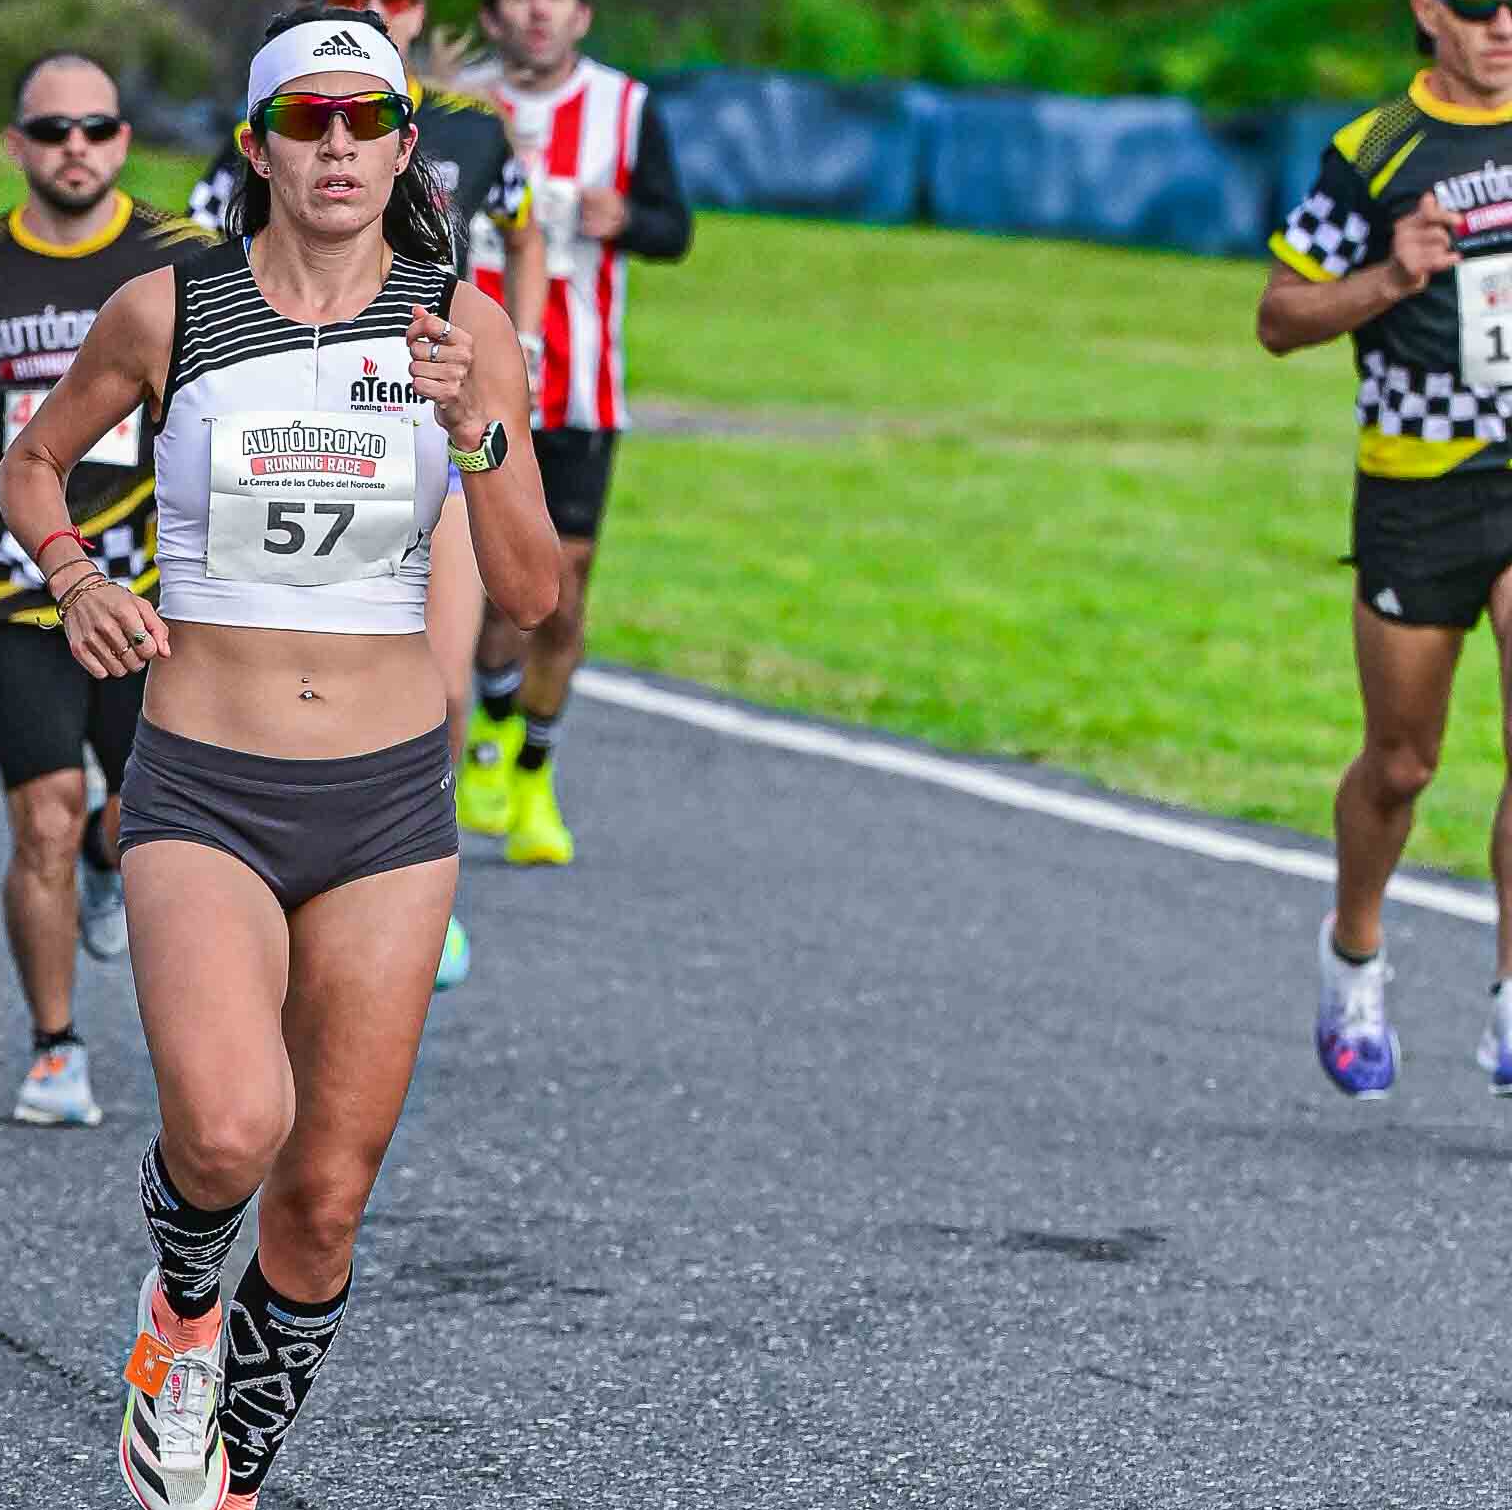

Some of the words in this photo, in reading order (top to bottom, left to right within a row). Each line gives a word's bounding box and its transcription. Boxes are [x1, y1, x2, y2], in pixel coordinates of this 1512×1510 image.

[312, 45, 371, 60] adidas
[350, 376, 427, 404] ATENA
[350, 403, 382, 413] running
[242, 420, 386, 459] AUTÓDROMO
[263, 456, 324, 474] RUNNING
[327, 457, 361, 475] RACE
[238, 477, 248, 487] La
[249, 478, 280, 487] Carrera
[281, 478, 293, 487] de
[293, 478, 305, 488] los
[307, 478, 334, 488] Clubes
[335, 479, 349, 489] del
[350, 480, 386, 490] Noroeste
[264, 501, 356, 557] 57
